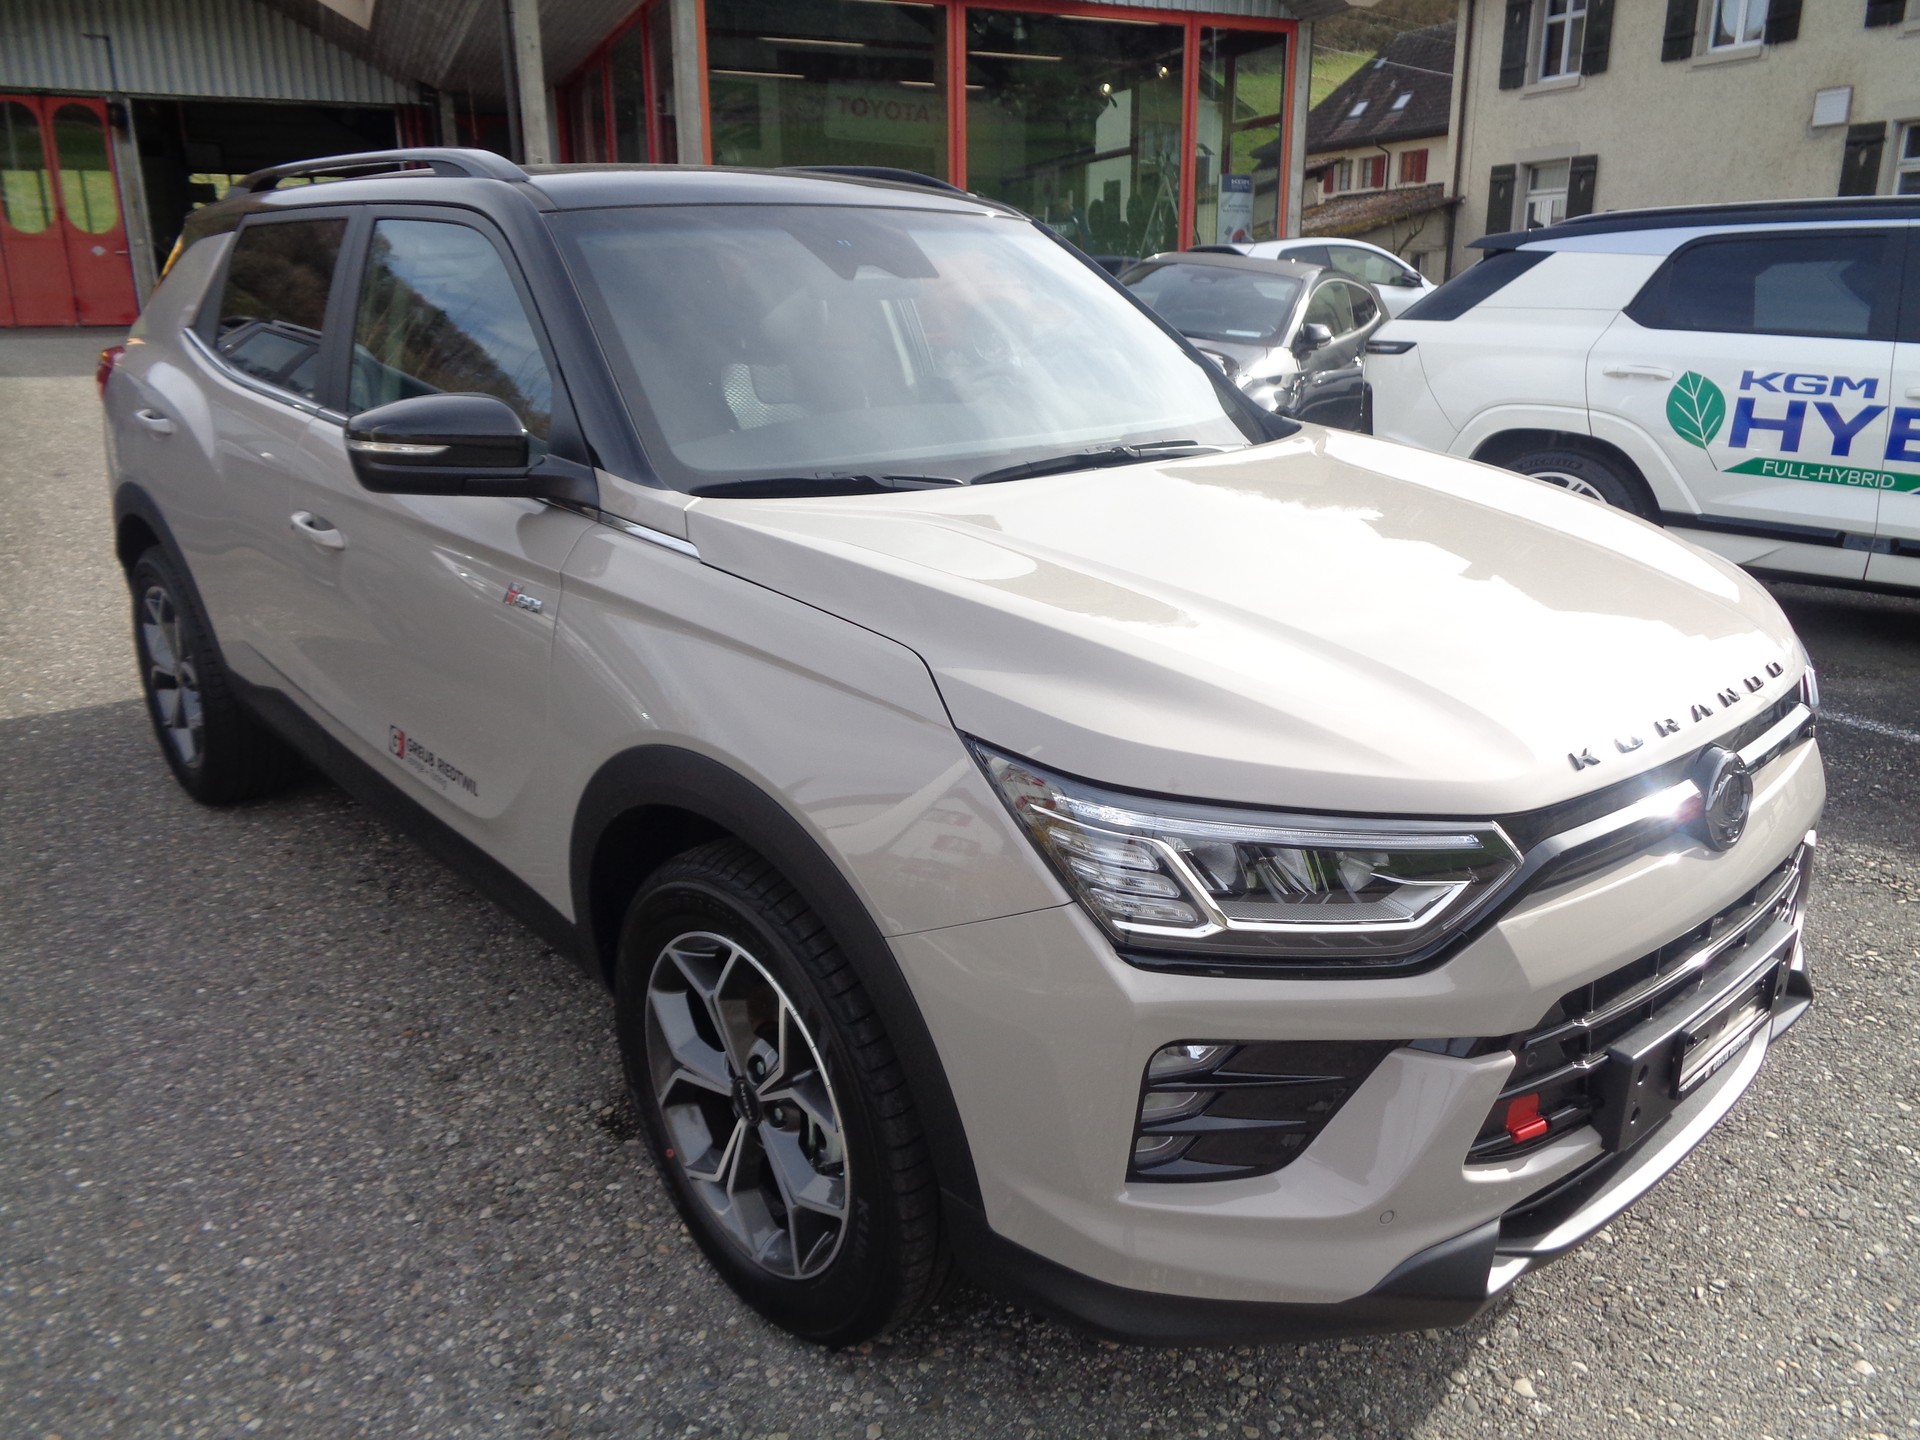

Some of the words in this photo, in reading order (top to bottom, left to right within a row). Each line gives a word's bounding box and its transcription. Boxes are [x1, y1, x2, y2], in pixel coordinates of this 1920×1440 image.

[837, 96, 930, 123] TOYOTA
[1740, 370, 1879, 399] KGM
[1761, 460, 1896, 489] FULL-HYBRID
[1567, 660, 1784, 772] KORANDO
